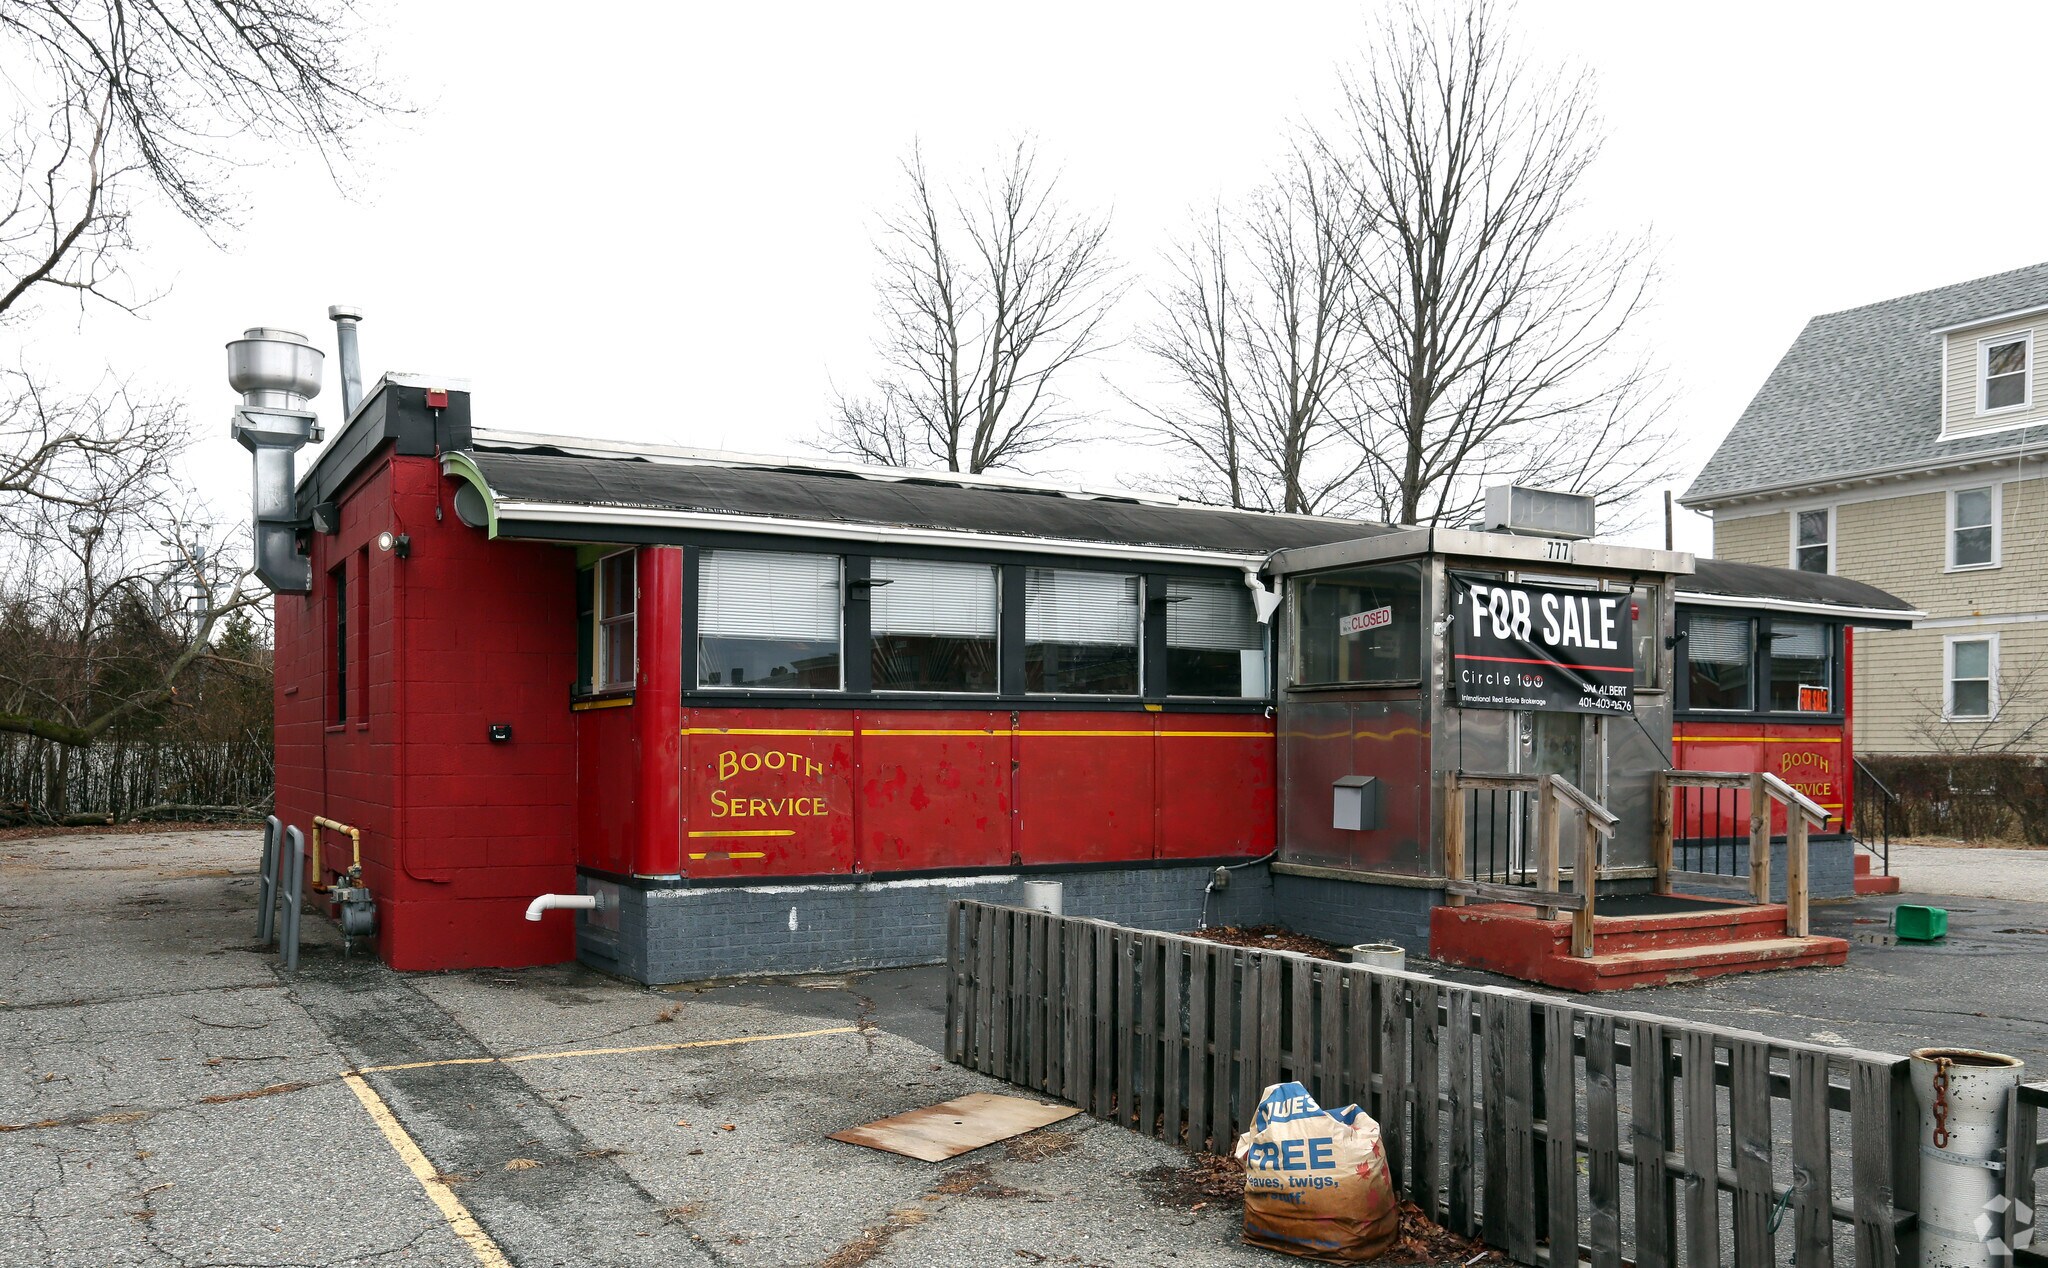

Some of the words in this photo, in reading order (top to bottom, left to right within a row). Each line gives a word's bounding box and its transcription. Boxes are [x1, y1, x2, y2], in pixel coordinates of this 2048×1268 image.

[1547, 541, 1569, 561] 777
[1351, 610, 1390, 630] CLOSED
[1470, 585, 1532, 643] FOR
[1541, 593, 1618, 650] SALE
[1462, 670, 1511, 686] Circle
[1517, 673, 1544, 688] 100
[1461, 694, 1491, 702] Intrnational
[1505, 696, 1520, 704] Estate
[1520, 697, 1546, 706] Brokerage
[1598, 685, 1627, 696] ALBERT
[719, 750, 823, 781] BOOTH
[1782, 752, 1829, 774] BOOTH
[1780, 777, 1831, 796] RVICE
[711, 789, 829, 818] SERVICE
[1248, 1137, 1336, 1171] FREE
[1289, 1174, 1339, 1190] twigs,
